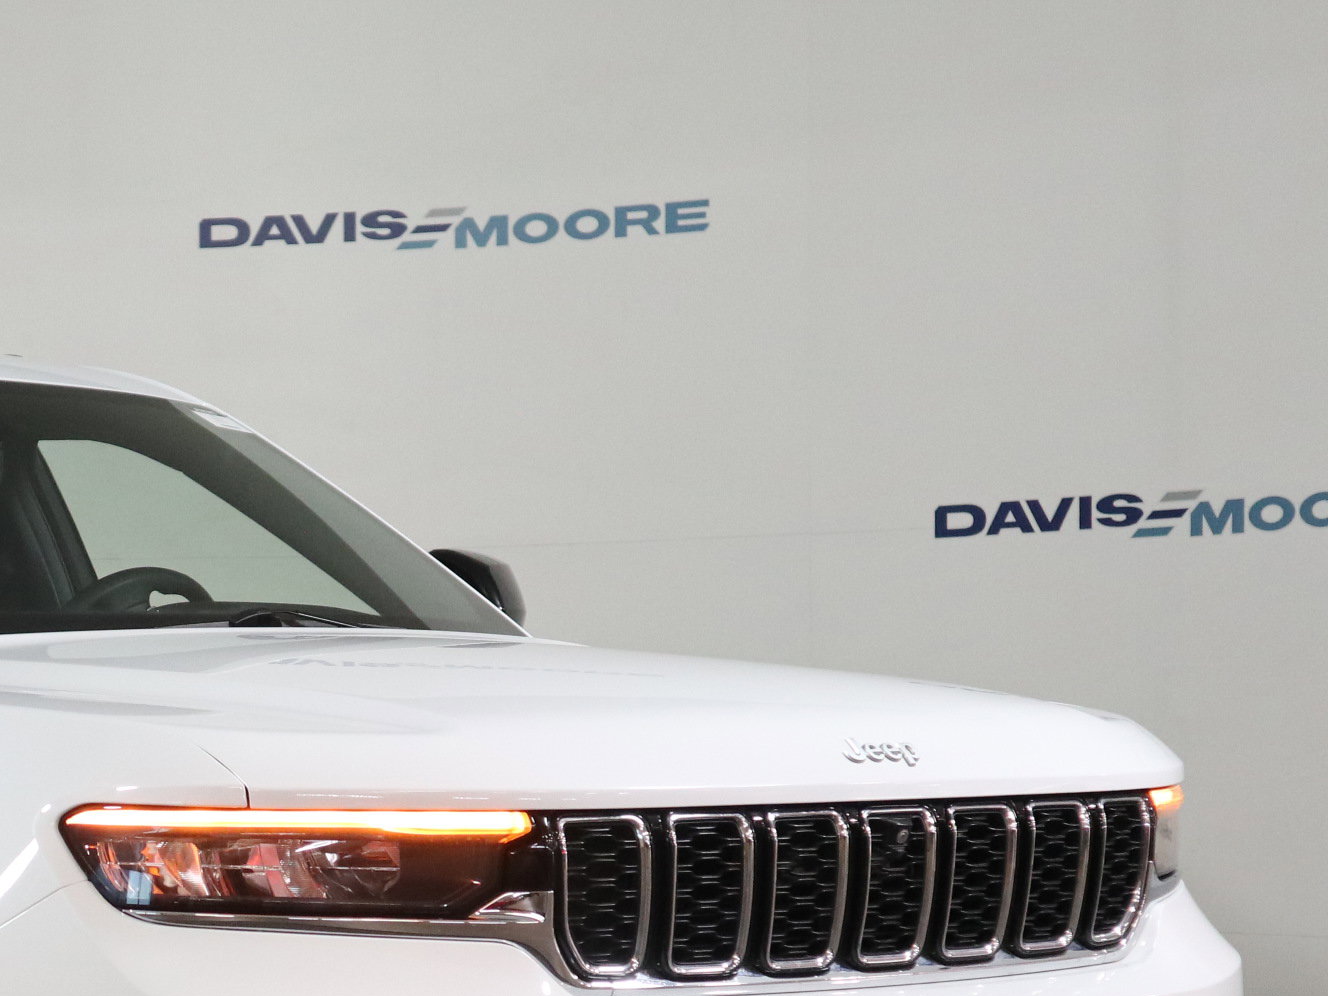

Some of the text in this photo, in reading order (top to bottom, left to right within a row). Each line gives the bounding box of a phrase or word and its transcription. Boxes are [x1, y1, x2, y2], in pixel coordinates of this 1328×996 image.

[199, 198, 710, 249] DAVIS MOORE
[934, 493, 1145, 539] DAVIS
[842, 737, 920, 768] Jeep
